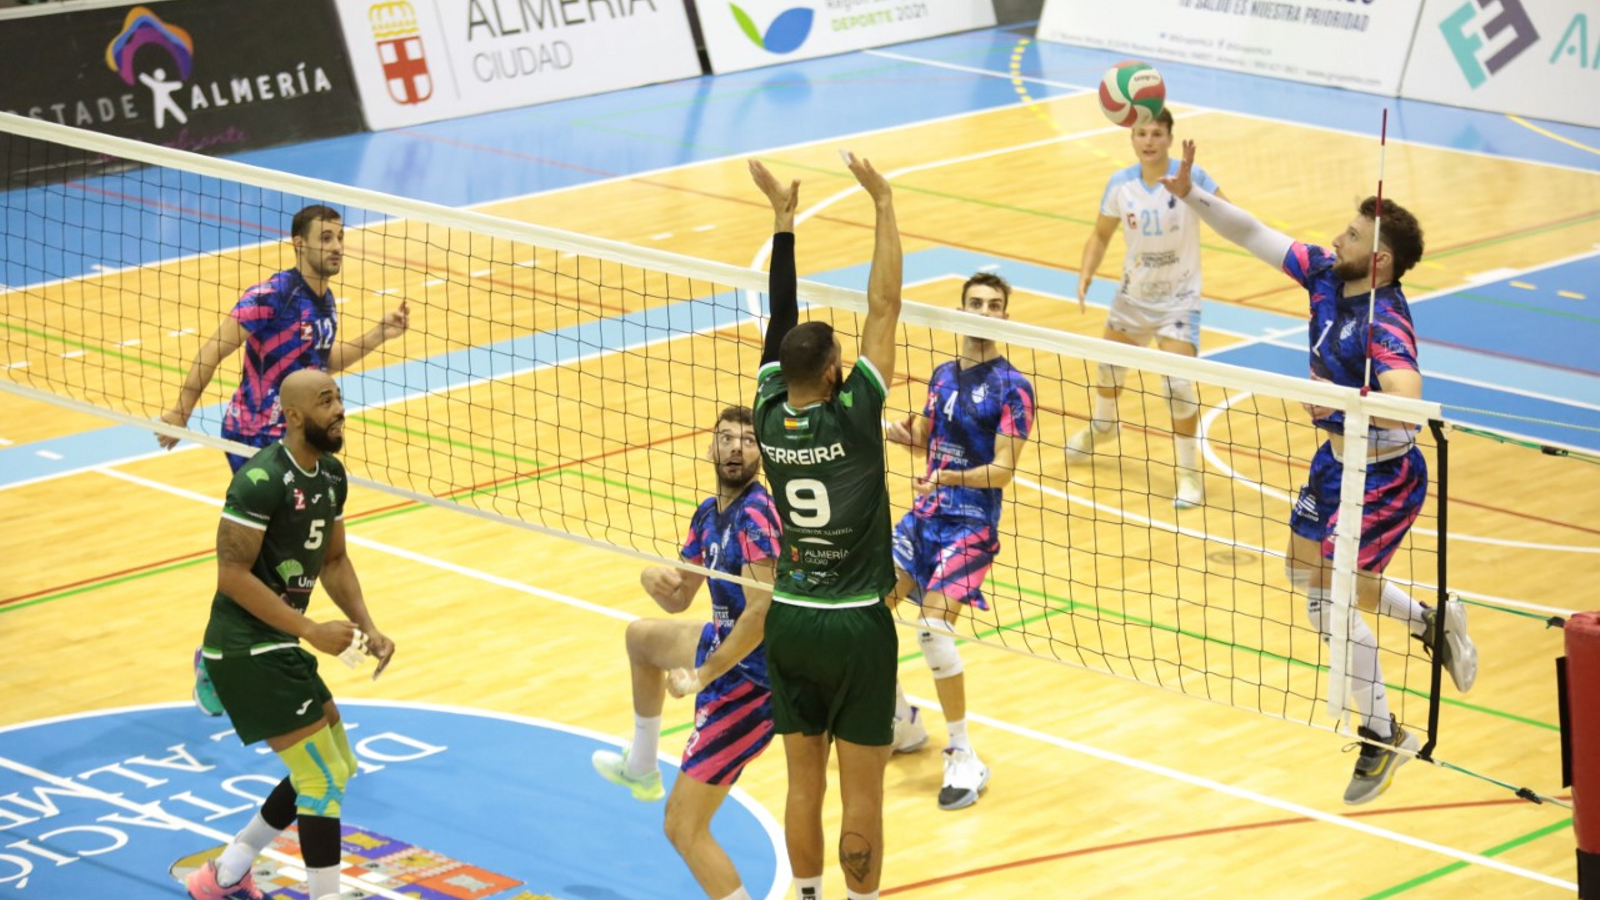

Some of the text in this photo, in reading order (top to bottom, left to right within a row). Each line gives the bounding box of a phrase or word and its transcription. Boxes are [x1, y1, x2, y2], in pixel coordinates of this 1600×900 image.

[467, 0, 657, 41] ALME
[830, 3, 928, 32] DEPORTE 2021
[1250, 1, 1301, 23] NUESTRA
[1304, 7, 1371, 32] PRIORIDAD
[472, 41, 574, 84] CIUDAD
[4, 62, 332, 127] STADE ALMERÍA
[1140, 209, 1163, 236] 21
[314, 318, 334, 349] 12
[943, 390, 959, 421] 4
[761, 442, 846, 465] ERREIRA
[785, 478, 831, 528] 9
[304, 519, 325, 550] 5
[710, 542, 720, 579] 2
[804, 547, 850, 559] ALMERÍA
